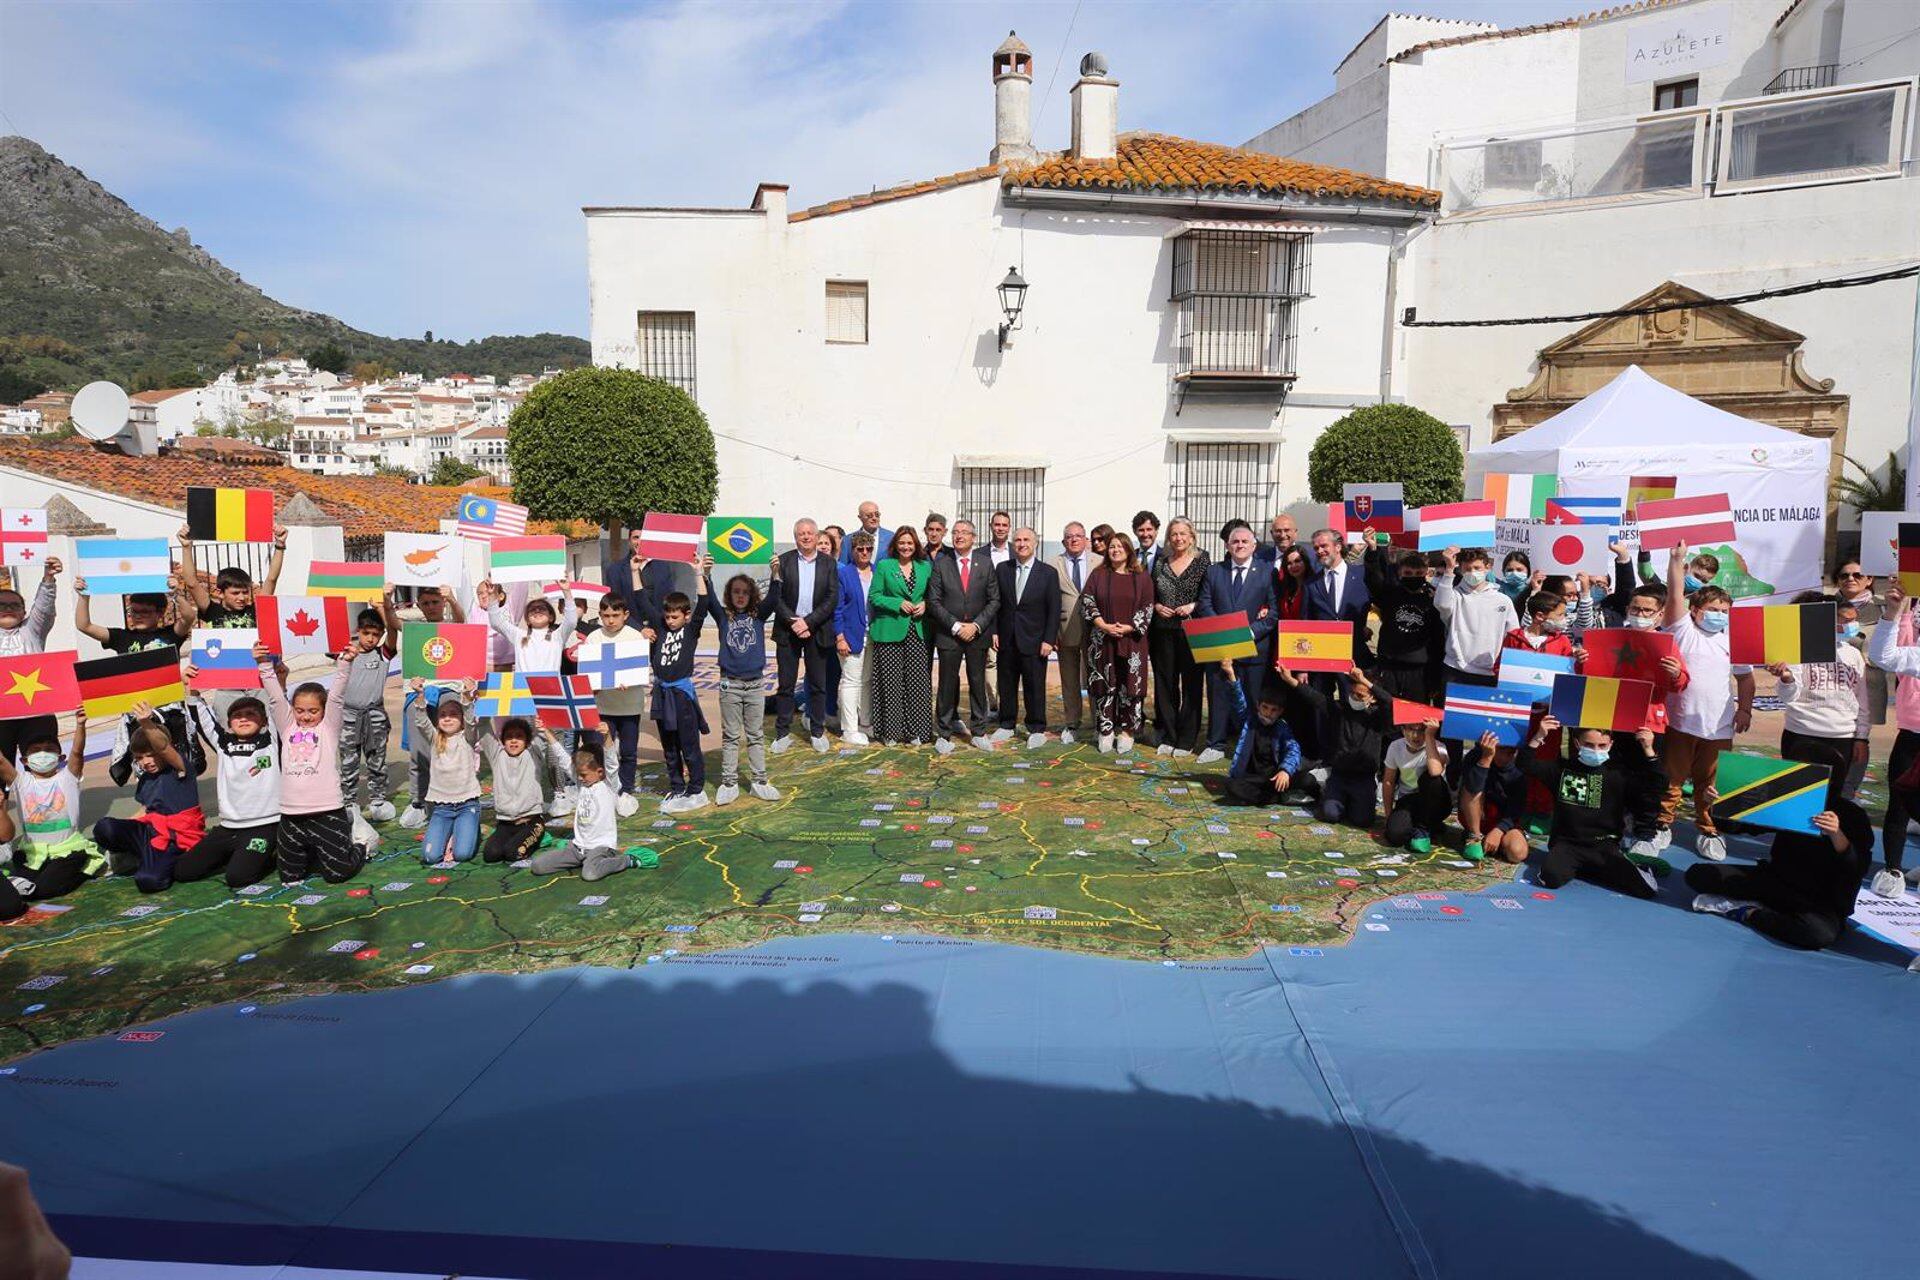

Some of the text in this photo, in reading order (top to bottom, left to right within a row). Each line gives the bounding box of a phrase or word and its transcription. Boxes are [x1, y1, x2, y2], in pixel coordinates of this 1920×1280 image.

[1633, 34, 1723, 63] AZULETE
[1762, 508, 1776, 521] DE
[1051, 919, 1111, 927] OCCIDENTAL
